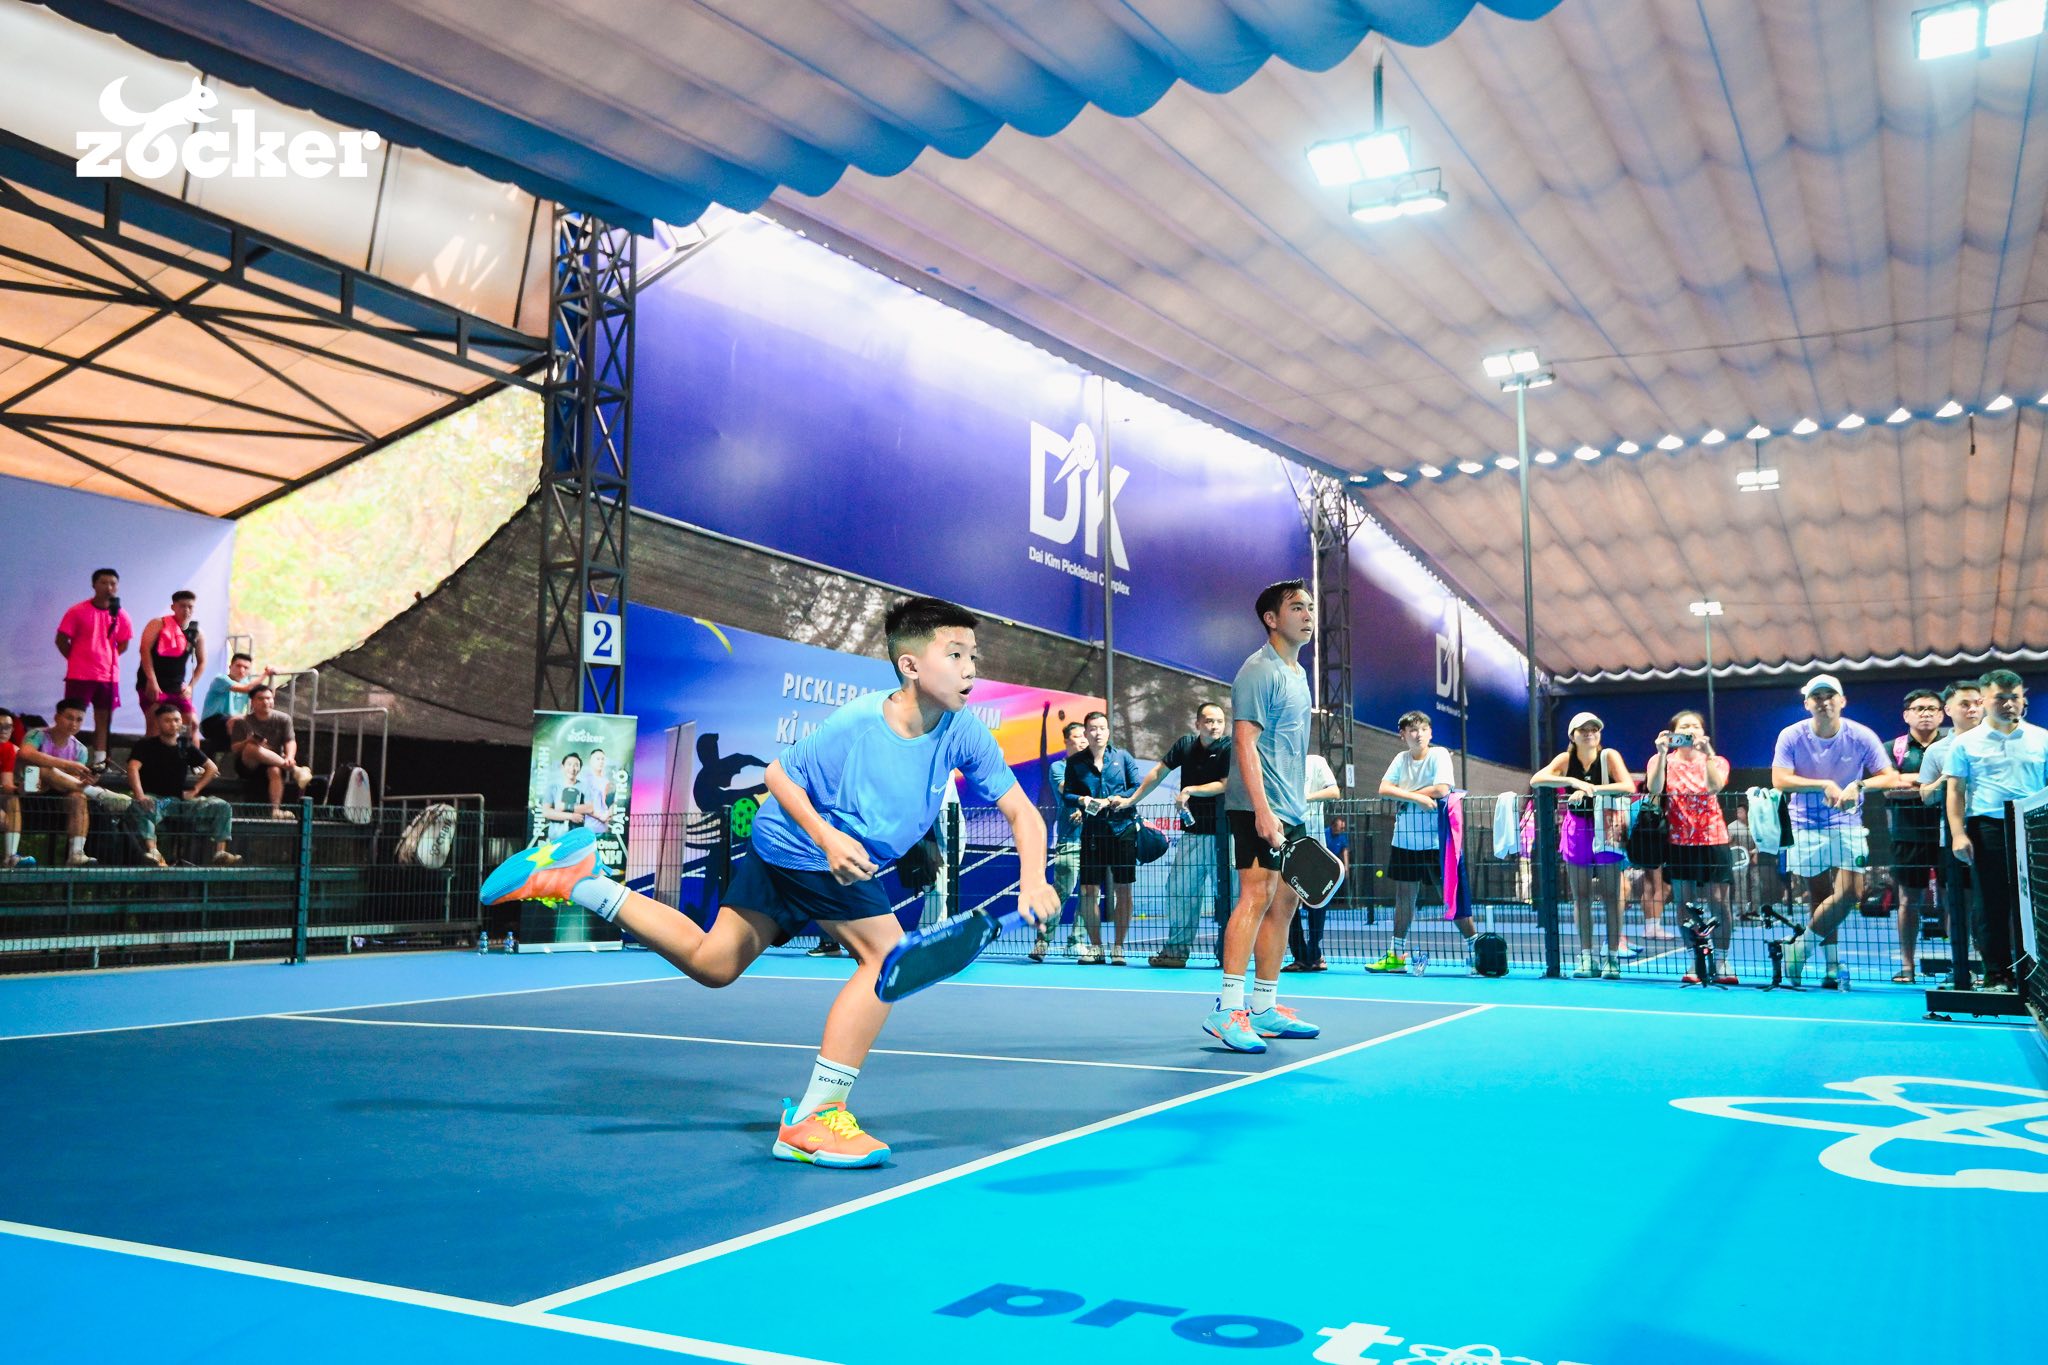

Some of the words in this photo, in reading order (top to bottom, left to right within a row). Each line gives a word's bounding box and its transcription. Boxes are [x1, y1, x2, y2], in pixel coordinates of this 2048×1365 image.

[1030, 421, 1130, 572] DK
[1044, 551, 1061, 571] Kim
[1061, 558, 1098, 584] Pickleball
[1098, 572, 1130, 596] Cplex
[593, 620, 613, 657] 2
